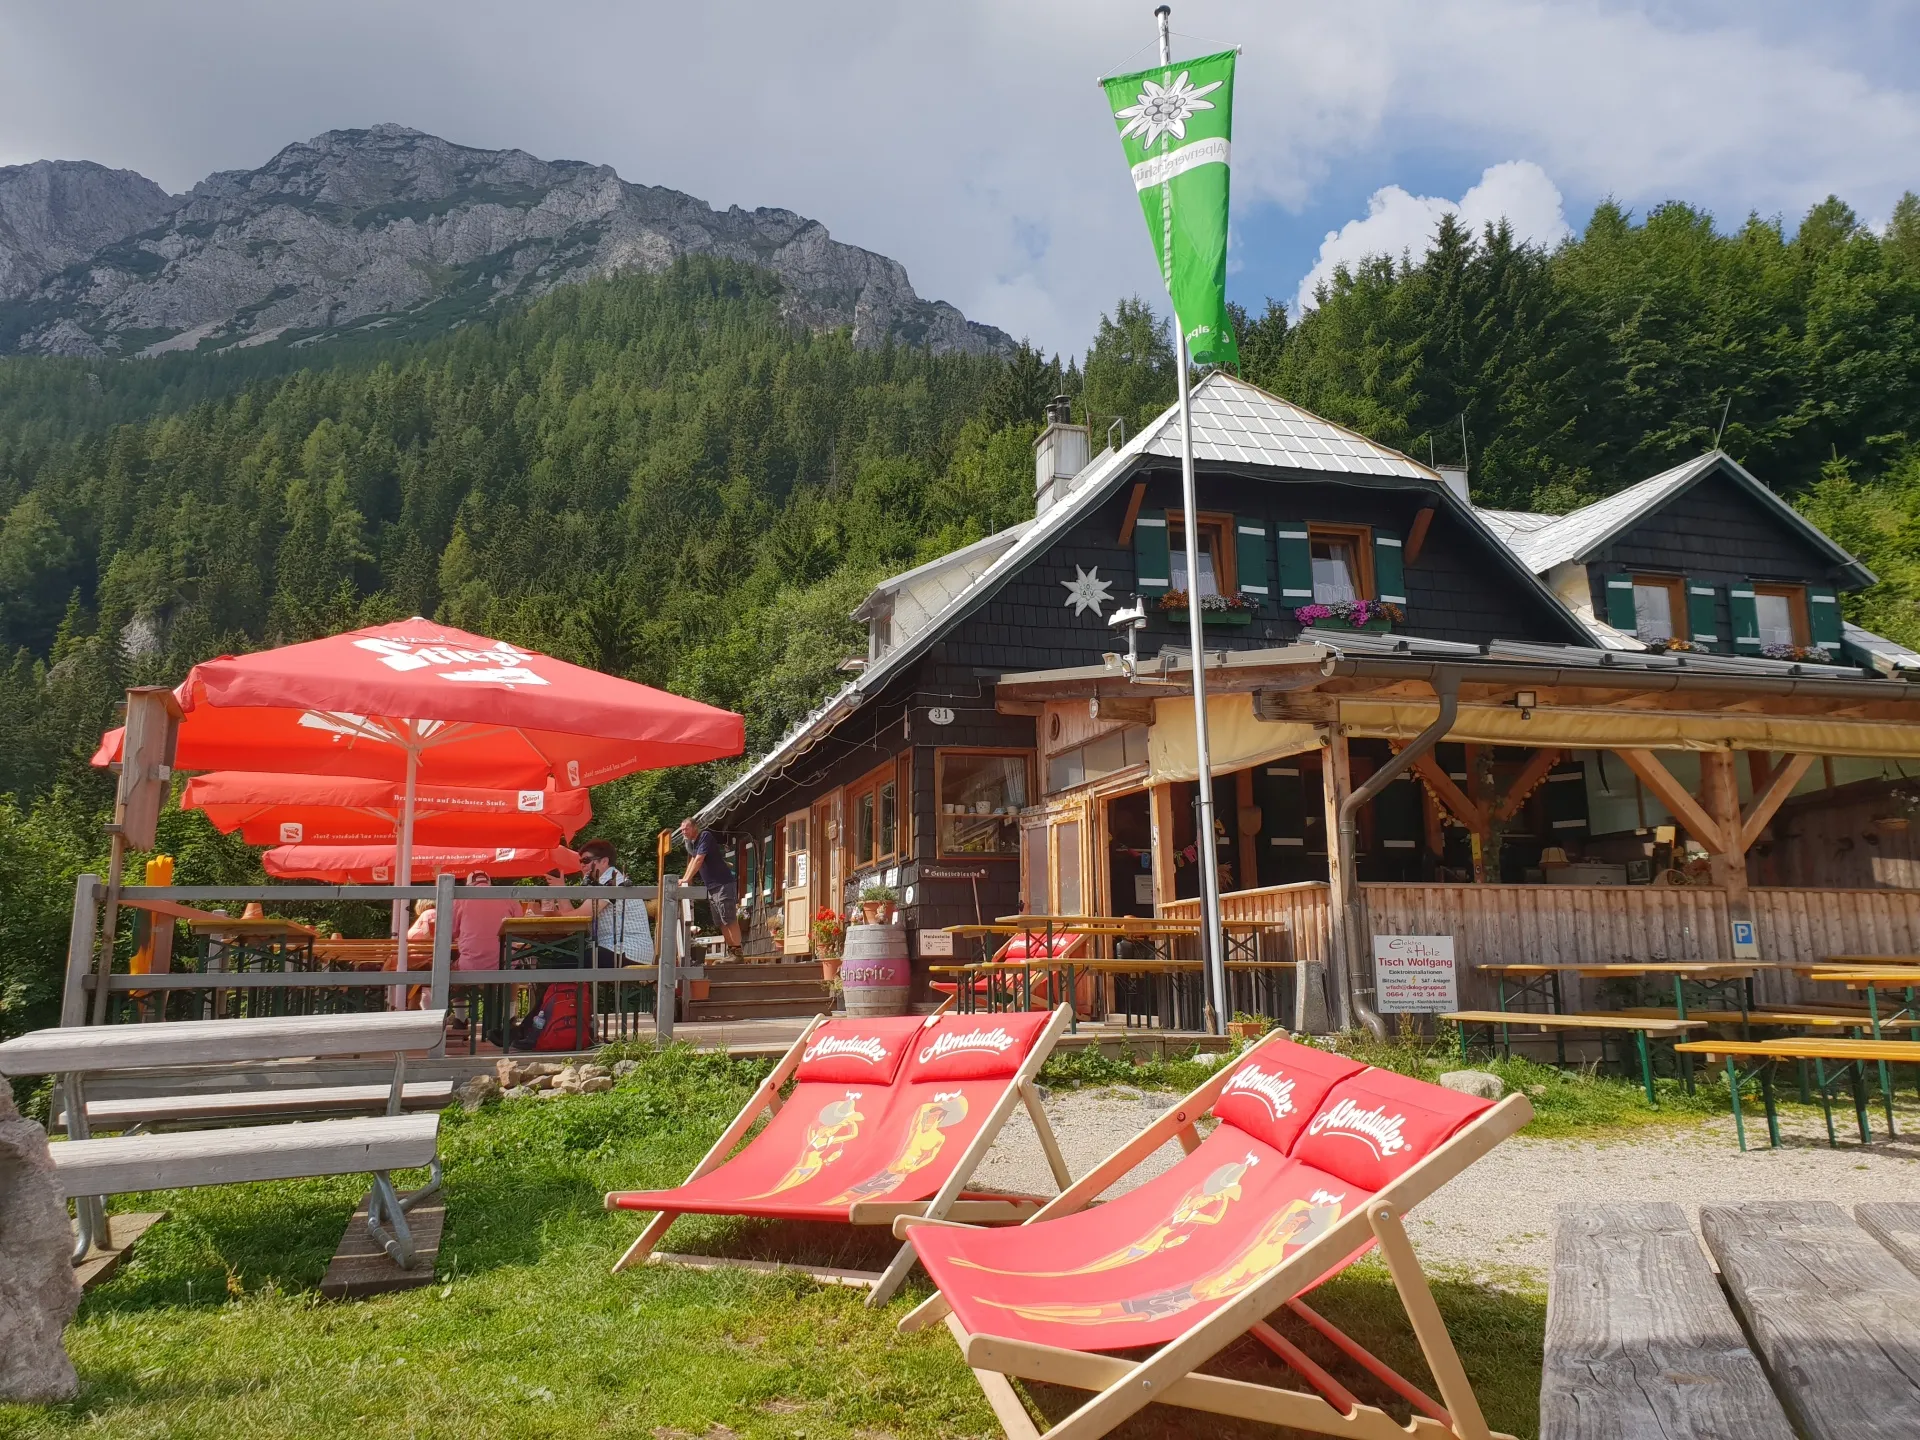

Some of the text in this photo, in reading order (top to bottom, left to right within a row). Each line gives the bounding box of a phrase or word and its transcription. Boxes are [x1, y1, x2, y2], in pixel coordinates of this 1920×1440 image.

[352, 638, 534, 672] Stiegl
[934, 708, 949, 719] 31
[394, 794, 434, 803] Brakunst
[452, 798, 484, 806] höchster
[1738, 926, 1748, 942] P
[1389, 939, 1422, 949] Elektro
[1414, 945, 1440, 957] Holz
[1378, 957, 1453, 968] Tisch Wolfgang
[802, 1035, 887, 1063] Almdudler
[919, 1028, 1014, 1064] Almdudler
[1221, 1064, 1296, 1118] Almdudler
[1309, 1098, 1406, 1156] Almdudler
